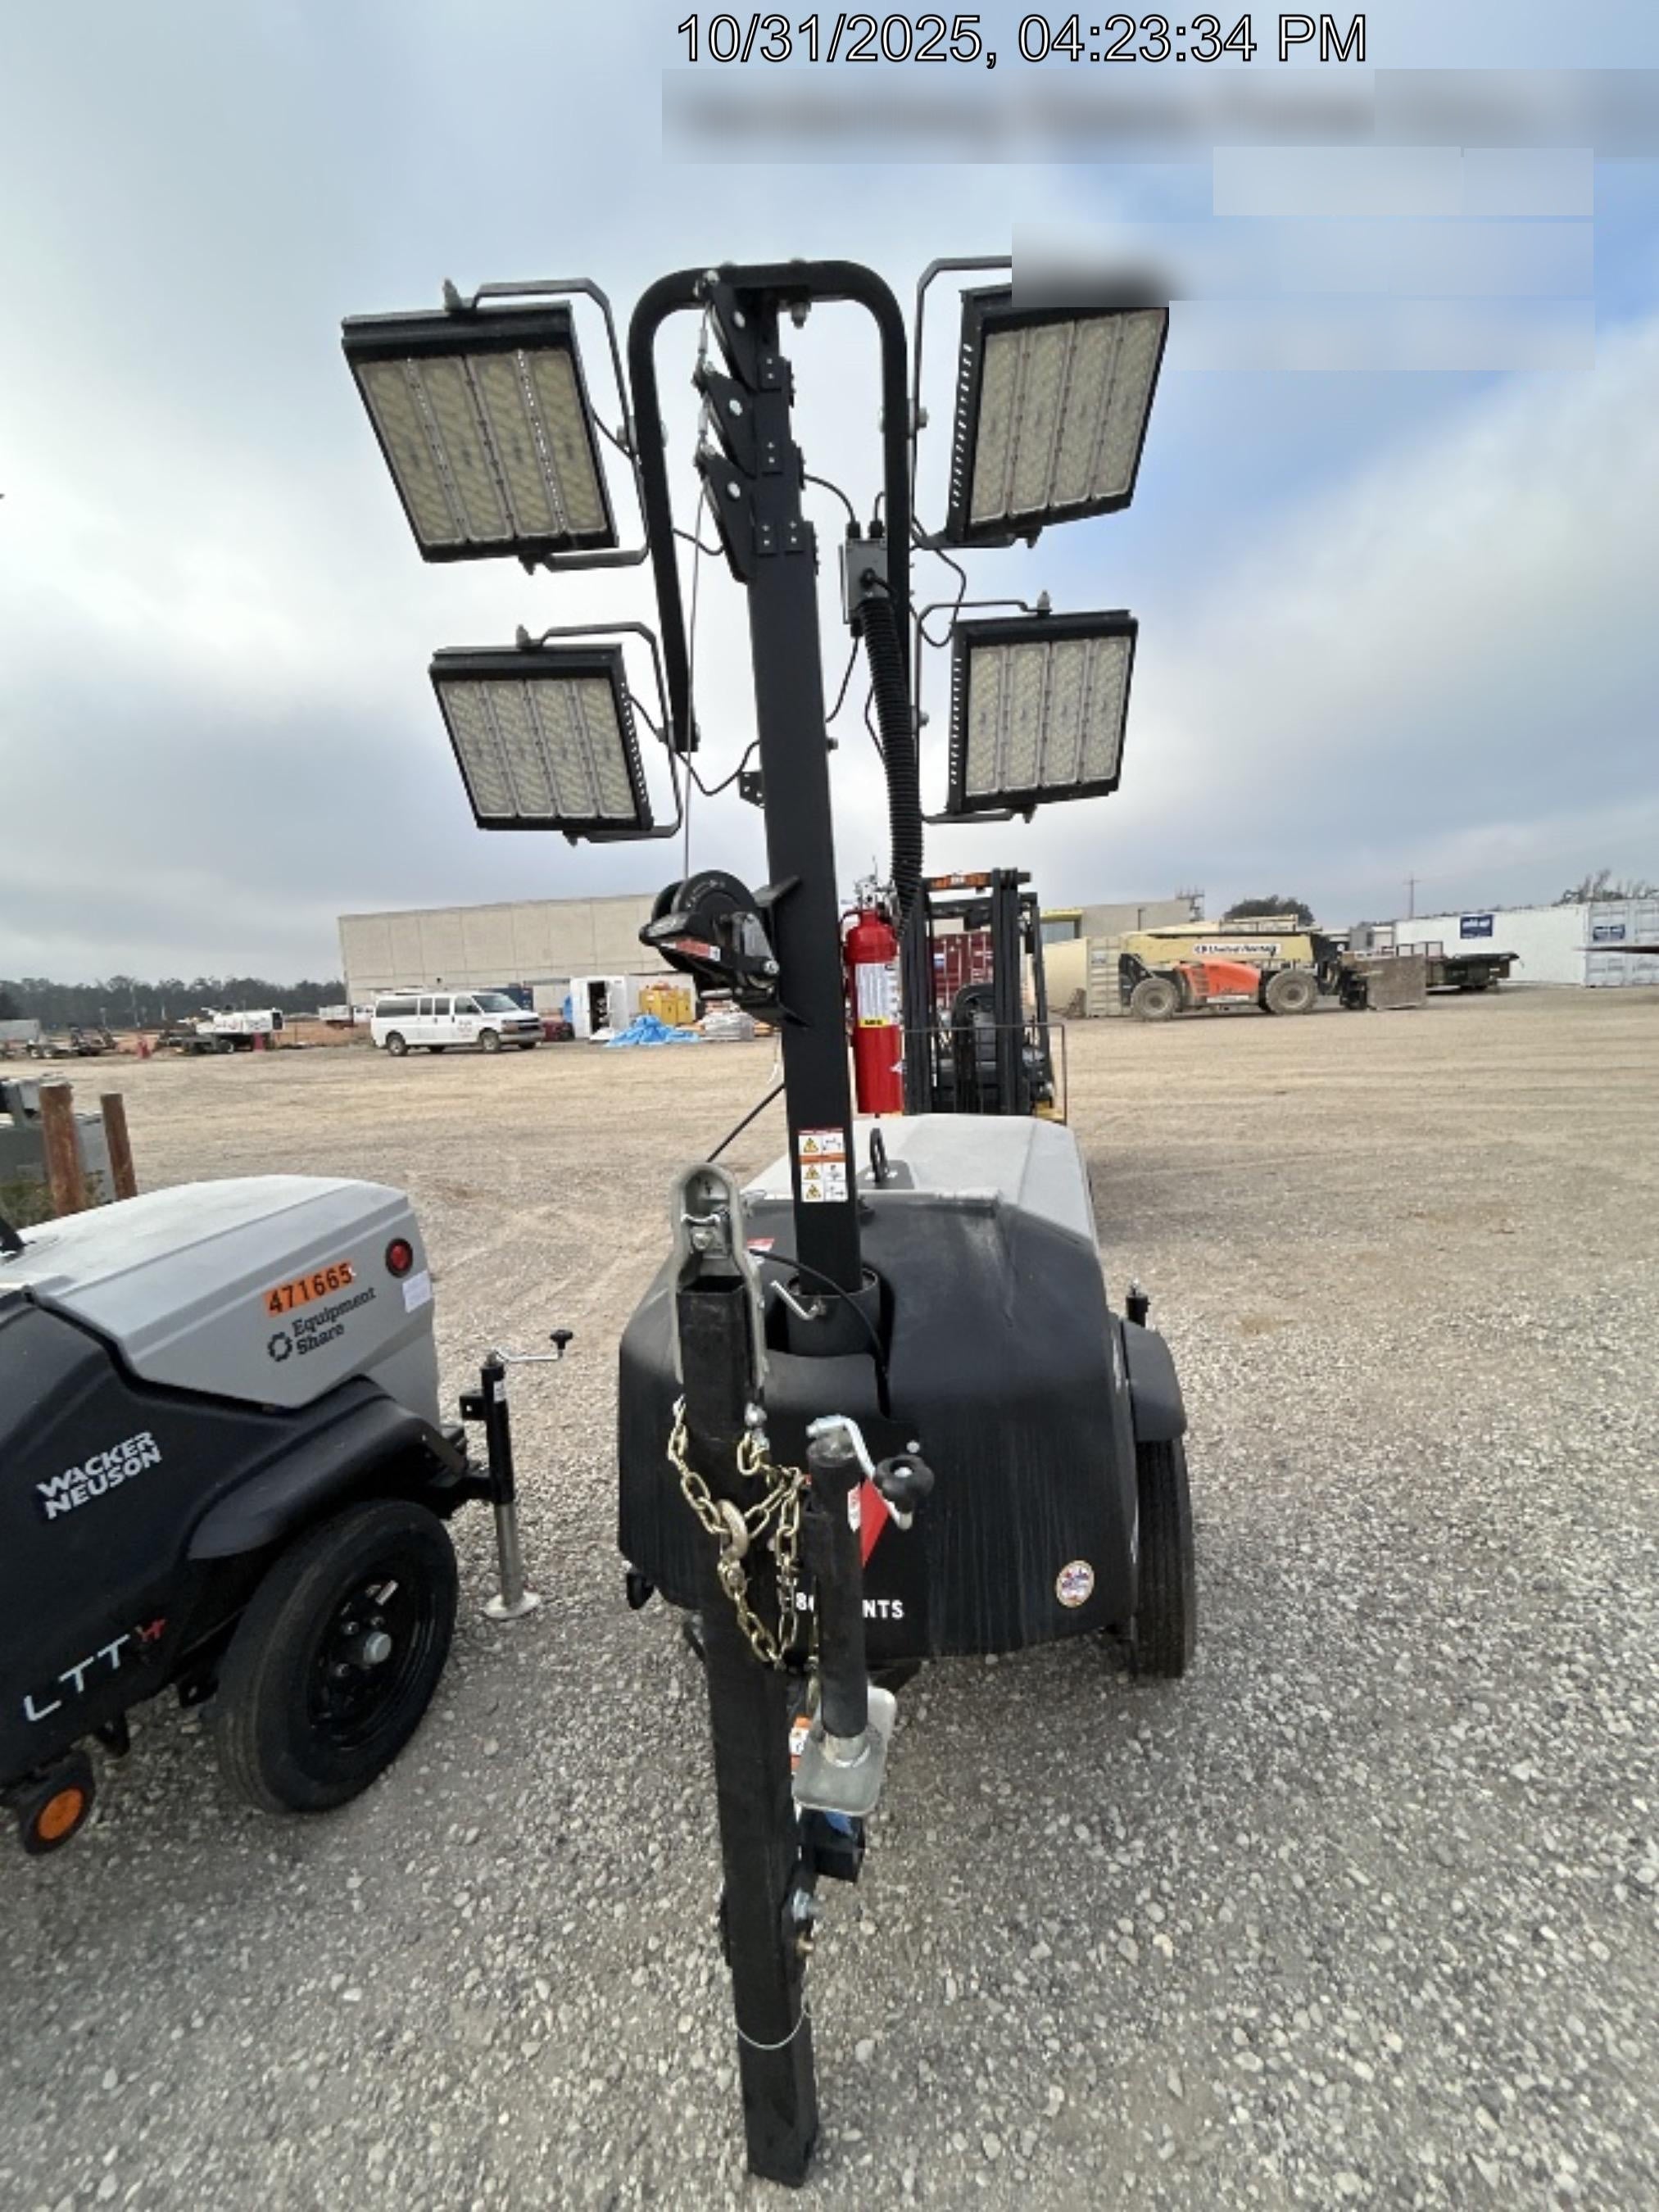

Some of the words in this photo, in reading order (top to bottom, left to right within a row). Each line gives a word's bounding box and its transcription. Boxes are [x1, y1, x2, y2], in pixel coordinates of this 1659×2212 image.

[269, 1262, 353, 1312] 471665
[292, 1287, 377, 1337] Equipment
[296, 1323, 345, 1355] Share
[36, 1431, 155, 1498] WACKER
[45, 1444, 162, 1520] NEUSON
